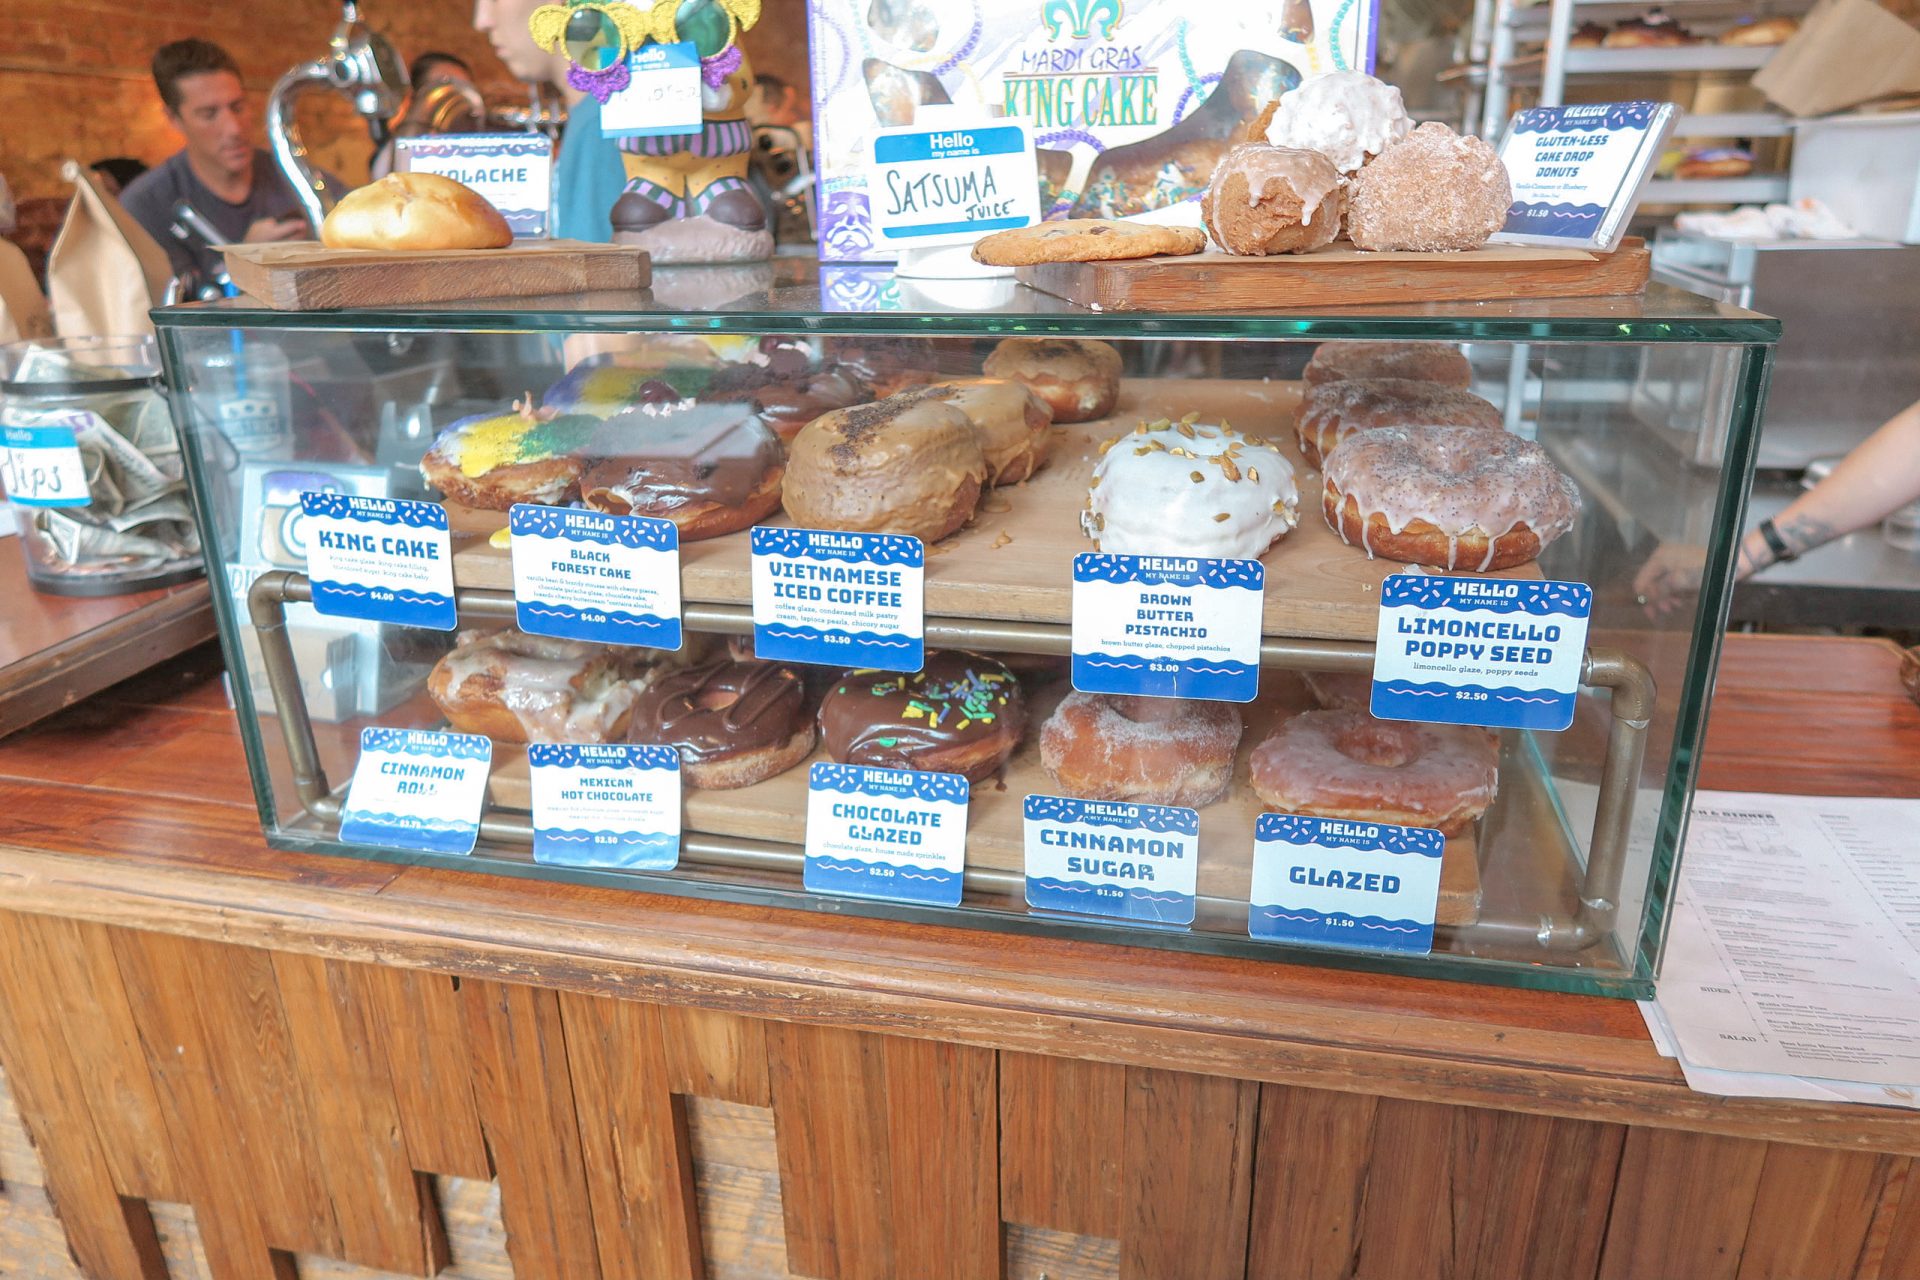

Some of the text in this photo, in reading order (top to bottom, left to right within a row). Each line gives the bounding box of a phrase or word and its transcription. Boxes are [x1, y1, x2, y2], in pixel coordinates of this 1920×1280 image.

[1021, 45, 1142, 72] MARDI GRAS
[1003, 75, 1158, 128] KING CAKE
[930, 132, 974, 149] Hello
[1536, 134, 1610, 147] GLUTEN-LESS
[932, 151, 944, 159] my
[1535, 151, 1594, 162] CAKE DROP
[433, 168, 528, 185] OLACHE
[1536, 167, 1580, 178] DONUTS
[887, 165, 997, 215] SATSUMA
[965, 198, 1015, 221] JUICE
[1527, 209, 1549, 218] $1.50
[349, 497, 397, 513] HELLO
[565, 514, 615, 532] HELLO
[582, 530, 599, 538] NAME
[319, 530, 439, 560] KING CAKE
[808, 534, 863, 549] HELLO
[570, 549, 611, 562] BLACK
[828, 549, 848, 557] NAME
[551, 562, 632, 580] FOREST CAKE
[1138, 557, 1200, 573] HELLO
[770, 561, 902, 587] VIETNAMESE
[1158, 572, 1182, 580] NAME
[370, 591, 394, 601] $4.00
[774, 582, 902, 608] ICED COFFEE
[1454, 582, 1519, 598] HELLO
[1140, 594, 1192, 606] BROWN
[1474, 598, 1498, 606] NAME
[580, 612, 606, 623] $4.00
[775, 603, 899, 621] coffee glaze, condensed milk pastry
[1136, 609, 1194, 622] BUTTER
[776, 614, 900, 630] cream, tapioca pearls, chicory sugar
[1126, 624, 1208, 638] PISTACHIO
[1398, 617, 1562, 642] LIMONCELLO
[824, 634, 852, 645] $3.50
[1124, 640, 1144, 648] butter
[1144, 642, 1164, 650] glaze,
[1166, 643, 1196, 652] chopped
[1196, 644, 1232, 652] pistachios
[1405, 640, 1554, 664] POPPY SEED
[1149, 663, 1180, 673] $3.00
[1414, 662, 1539, 678] limoncello glaze, poppy seeds
[1456, 690, 1488, 702] $2.50
[407, 732, 448, 746] HELLO
[579, 746, 627, 758] HELLO
[380, 762, 466, 781] CINNAMON
[864, 770, 913, 786] HELLO
[580, 778, 633, 788] MEXICAN
[561, 790, 654, 802] HOT CHOCOLATE
[832, 803, 942, 828] CHOCOLATE
[1084, 803, 1140, 818] HELLO
[1104, 816, 1124, 825] NAME
[848, 825, 922, 846] GLAZED
[1320, 822, 1380, 838] HELLO
[594, 836, 618, 844] $2.50
[1040, 828, 1184, 859] CINNAMON
[1339, 837, 1362, 845] NAME
[823, 841, 854, 851] chocolate
[876, 846, 895, 855] house
[896, 849, 915, 858] made
[916, 852, 947, 862] sprinkles
[870, 867, 896, 878] $2.50
[1068, 856, 1155, 882] SUGAR
[1290, 866, 1401, 894] GLAZED
[1096, 888, 1124, 898] $1.50
[1326, 917, 1355, 928] $1.50
[1700, 986, 1731, 995] SIDES
[1719, 1033, 1757, 1043] SALAD
